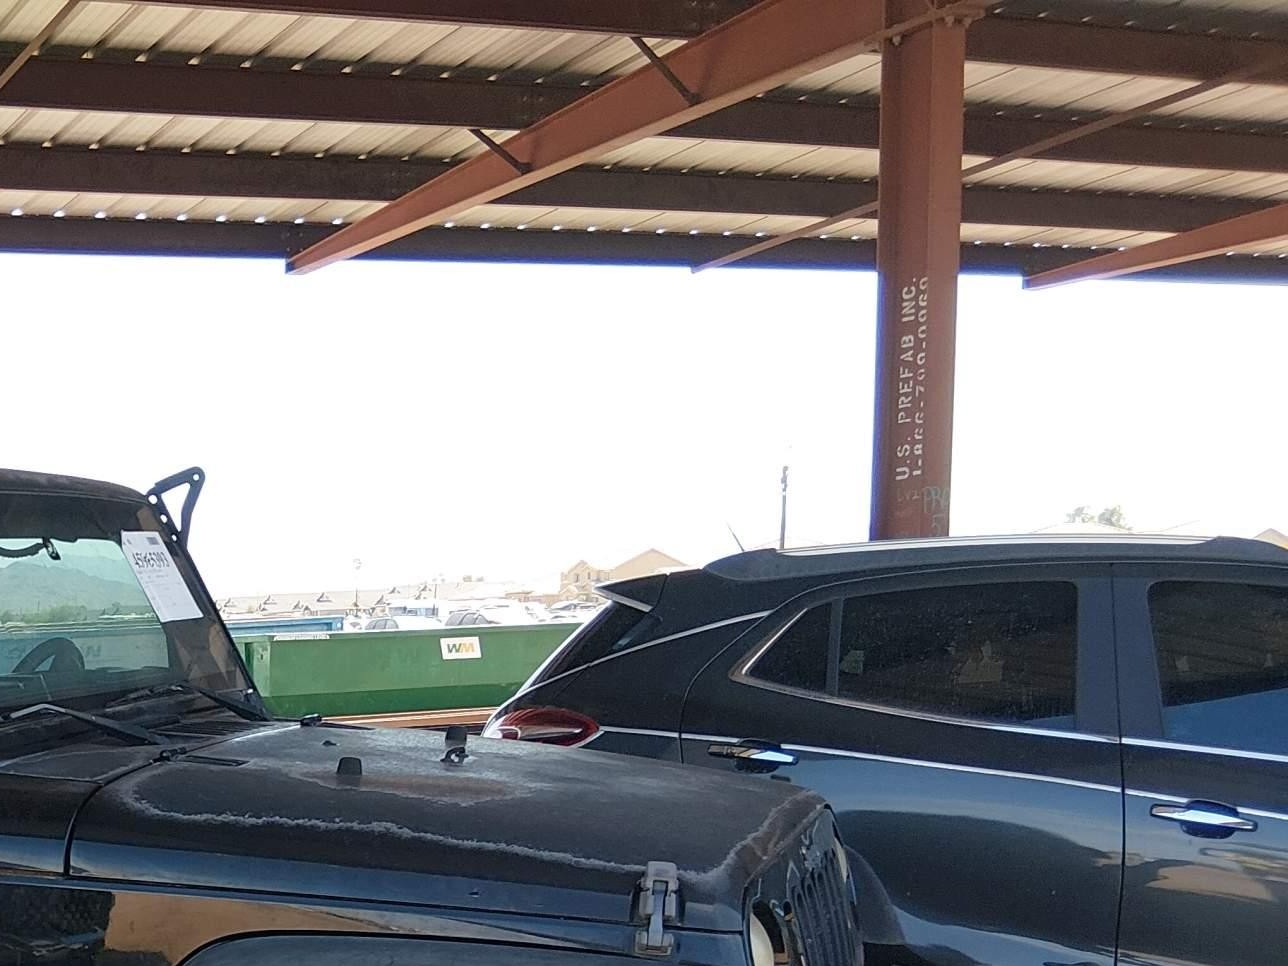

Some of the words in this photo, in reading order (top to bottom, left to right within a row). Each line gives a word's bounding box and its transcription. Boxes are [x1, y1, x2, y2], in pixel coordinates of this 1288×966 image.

[901, 277, 916, 322] INC.
[897, 335, 914, 424] PREFAB
[895, 436, 911, 480] U.S.
[447, 643, 475, 654] WM
